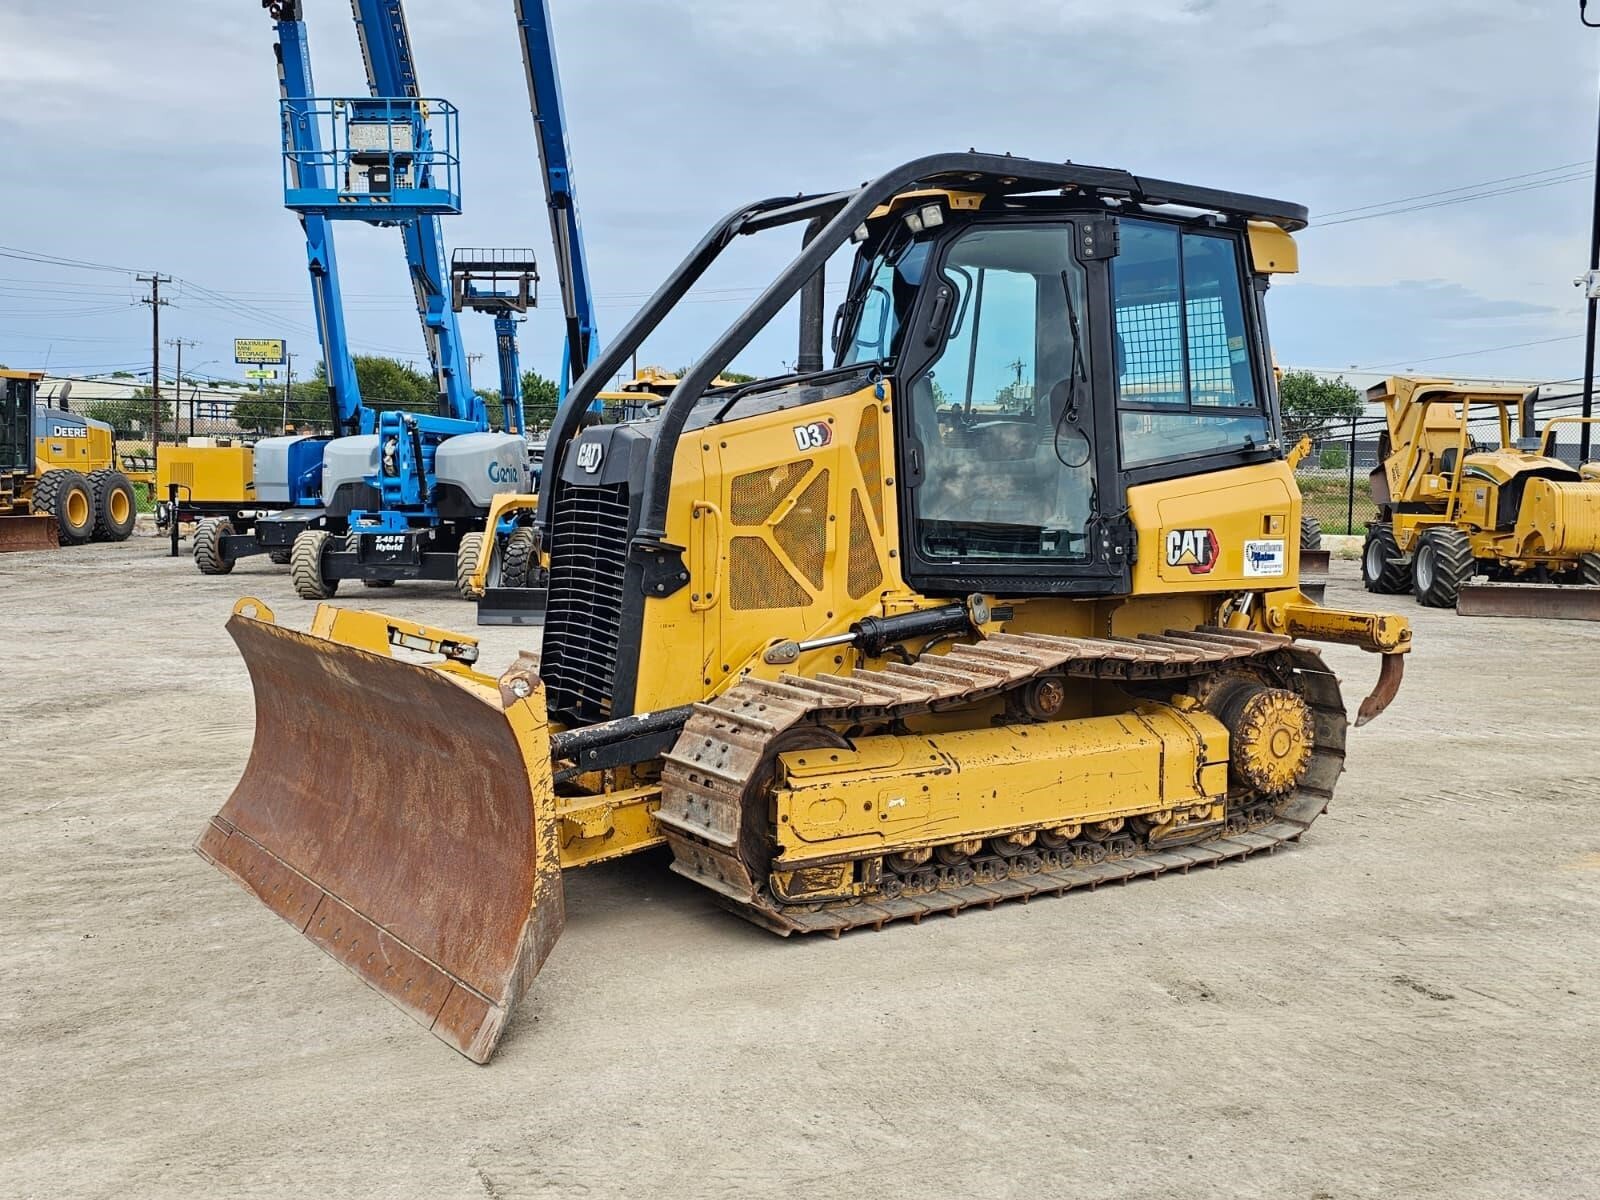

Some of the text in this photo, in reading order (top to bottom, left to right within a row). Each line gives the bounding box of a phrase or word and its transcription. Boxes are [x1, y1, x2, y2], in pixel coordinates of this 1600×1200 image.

[54, 425, 87, 437] DEERE
[793, 423, 823, 451] D3
[576, 442, 601, 468] CAT
[487, 461, 518, 484] Genie
[375, 543, 404, 552] Hybrid
[1166, 529, 1208, 566] CAT
